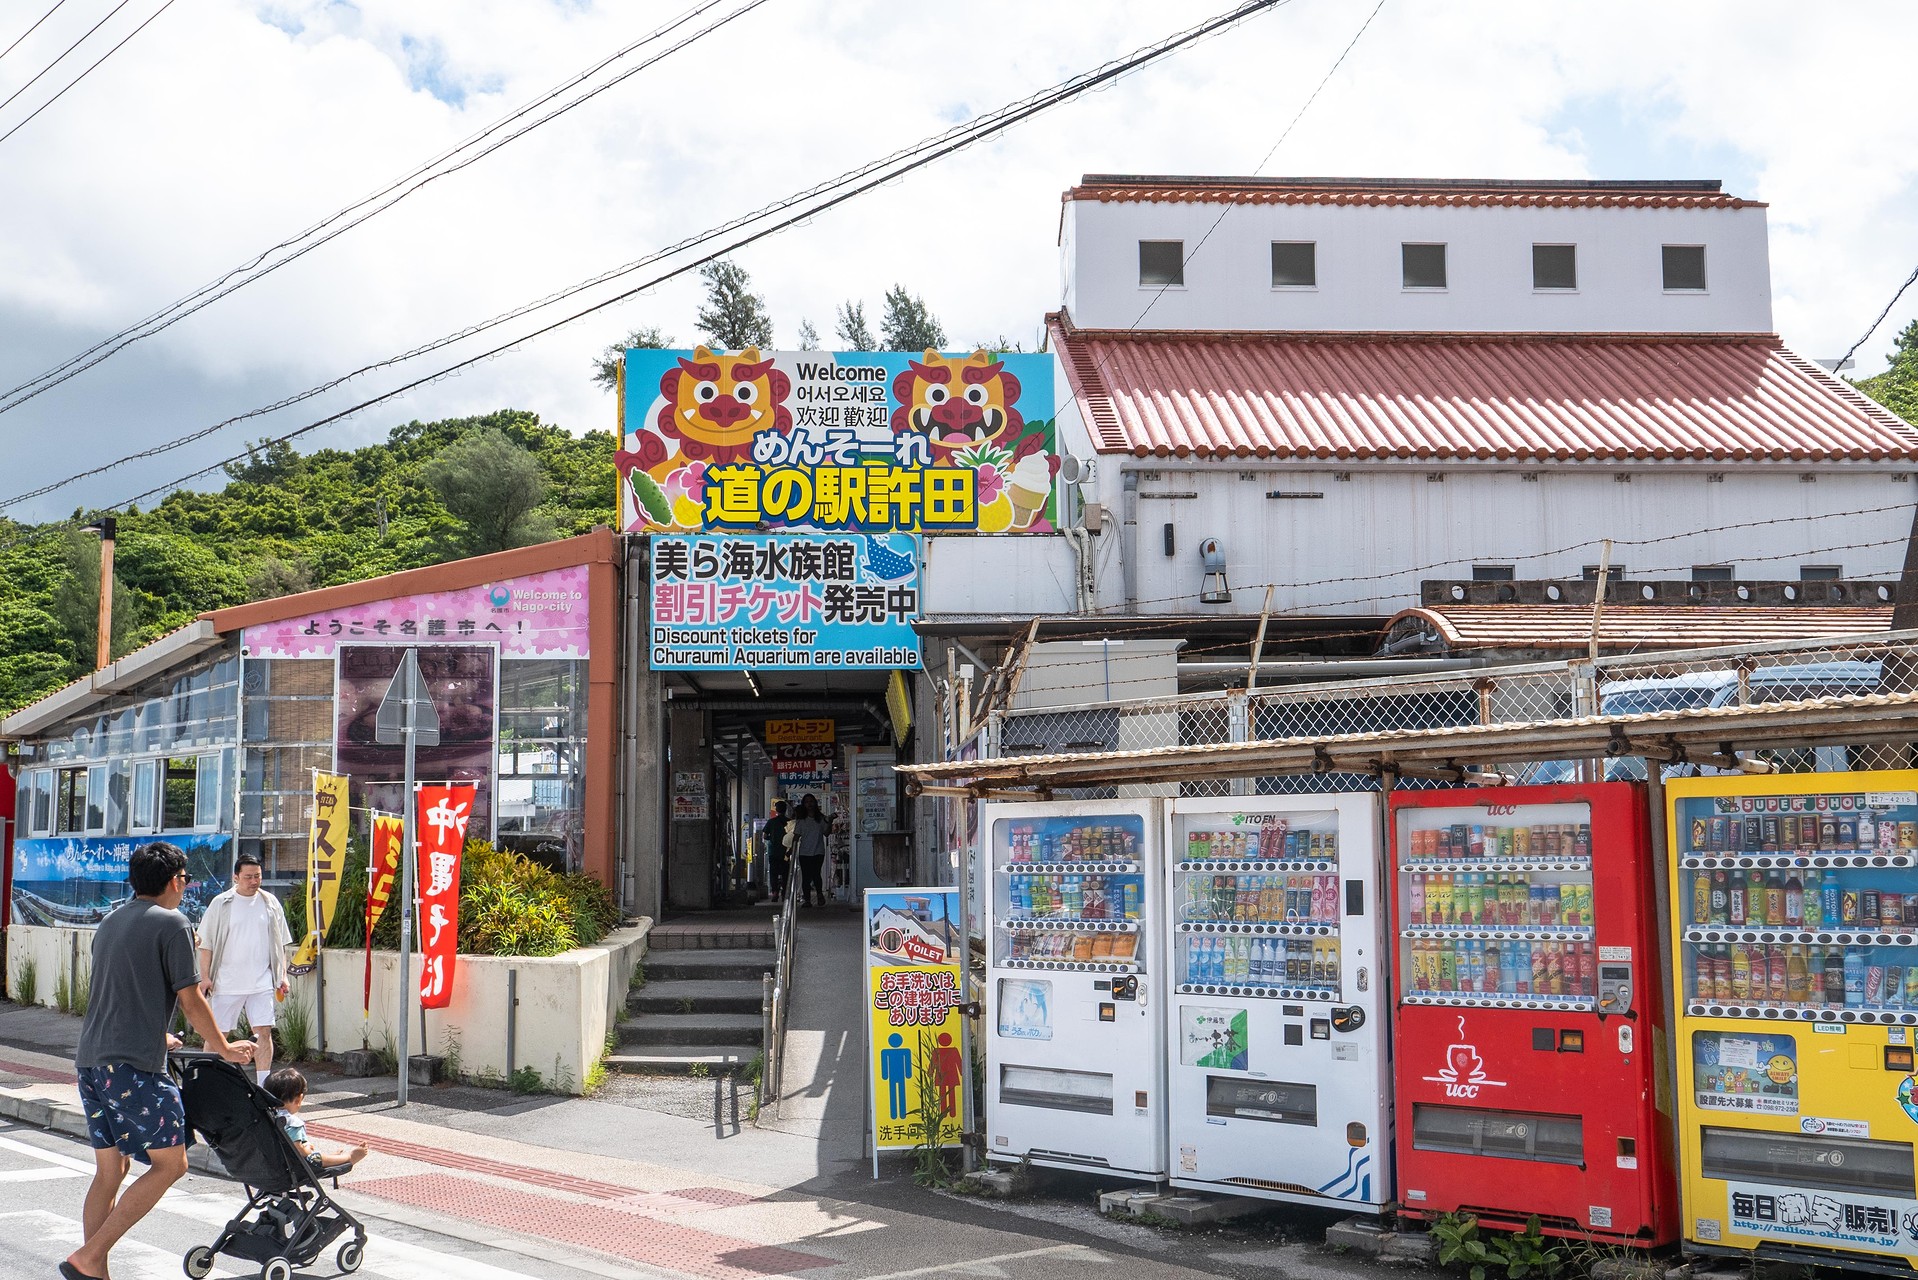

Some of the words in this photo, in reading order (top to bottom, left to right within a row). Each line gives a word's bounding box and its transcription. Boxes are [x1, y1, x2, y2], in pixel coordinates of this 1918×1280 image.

[796, 363, 887, 382] Welcome
[797, 385, 887, 403] 어서오세요
[796, 406, 840, 427] 欢迎
[843, 406, 888, 428] 歡迎
[753, 431, 932, 466] めんそーれ
[706, 467, 975, 524] 道の駅許田
[655, 541, 855, 581] 美ら海水族館
[513, 590, 567, 600] Welcome
[569, 590, 582, 600] to
[655, 584, 917, 623] 割引チケット発売中
[513, 601, 573, 613] Nago-city
[654, 628, 727, 644] Discount
[730, 628, 789, 644] tickets
[793, 628, 816, 644] for
[654, 649, 729, 665] Churaumi
[733, 649, 810, 667] Aquarium
[813, 652, 841, 665] are
[845, 649, 917, 665] available
[770, 722, 830, 735] レストラン
[1742, 798, 1804, 810] SUPER
[1818, 797, 1865, 810] SHOP
[1245, 815, 1262, 824] ITO
[908, 941, 943, 962] TOILET
[880, 971, 955, 991] お手洗いは
[874, 989, 962, 1010] この建物内に
[888, 1006, 950, 1026] あります
[1817, 1023, 1842, 1032] LED照明
[1699, 1094, 1754, 1109] 設置先大募集
